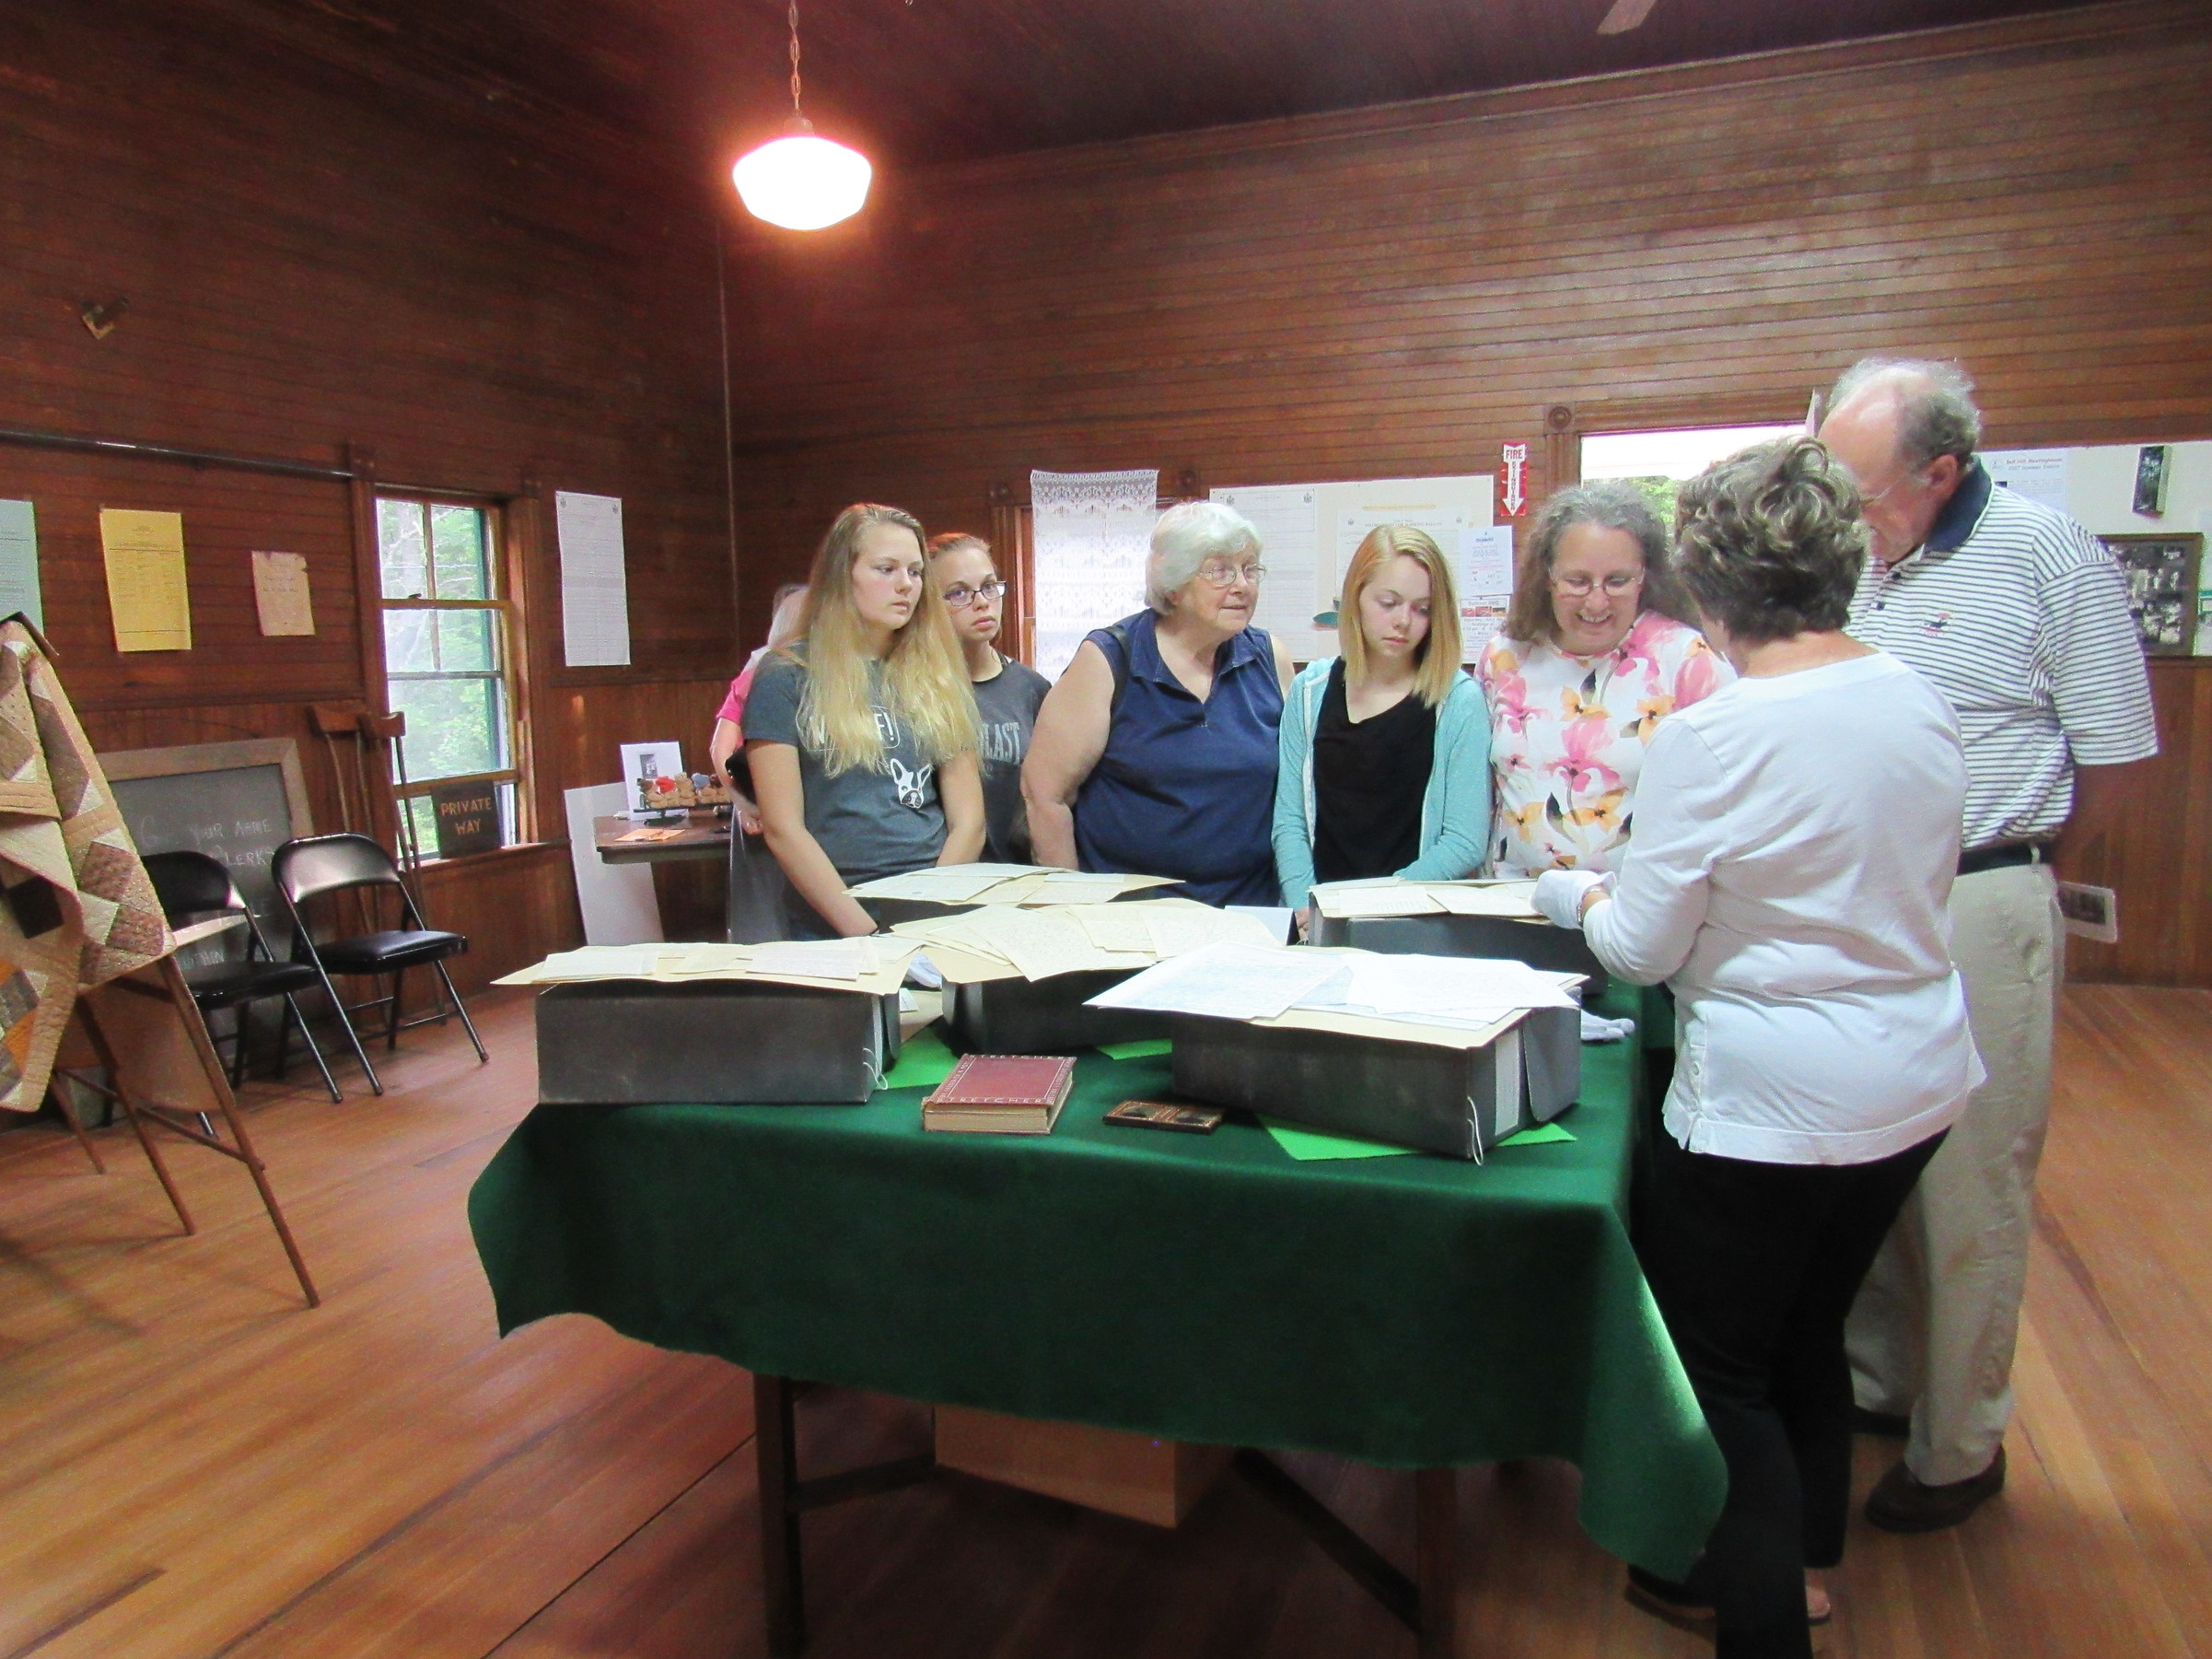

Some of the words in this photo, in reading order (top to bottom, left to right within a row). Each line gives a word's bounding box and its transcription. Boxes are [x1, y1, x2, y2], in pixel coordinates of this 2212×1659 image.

[1506, 449, 1523, 460] FIRE
[439, 797, 492, 817] PRIVATE
[454, 819, 481, 835] WAY
